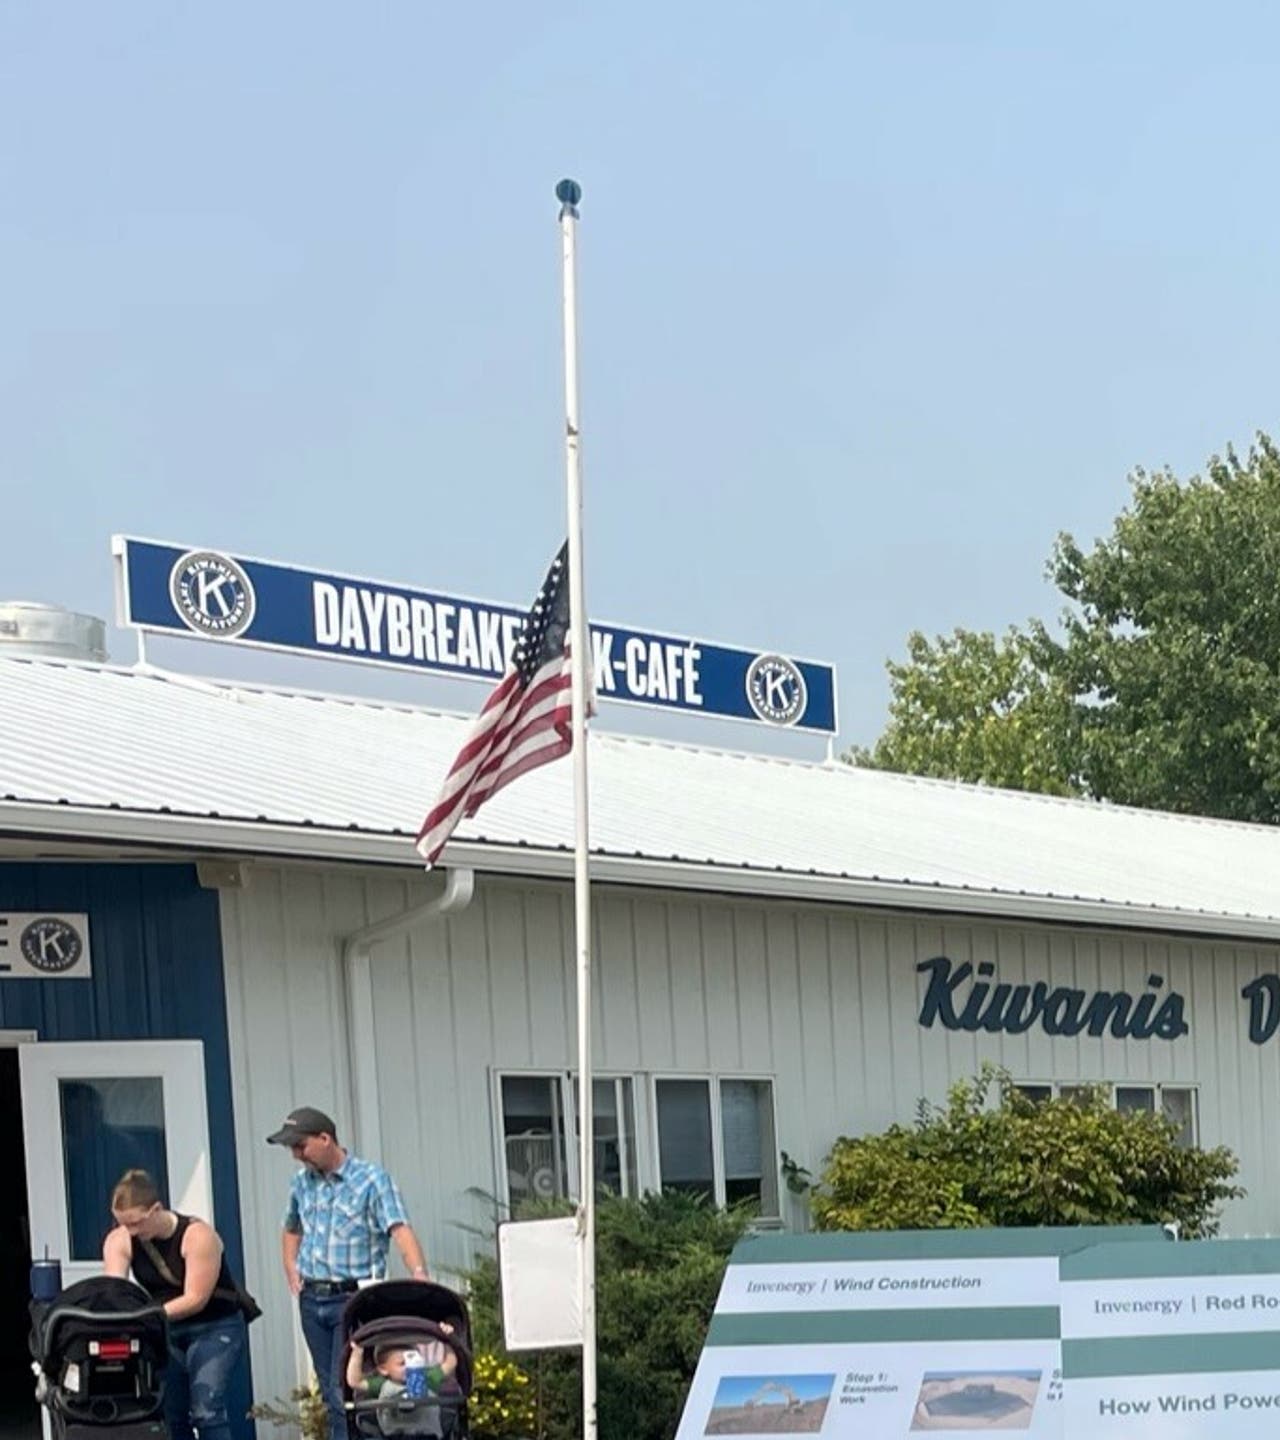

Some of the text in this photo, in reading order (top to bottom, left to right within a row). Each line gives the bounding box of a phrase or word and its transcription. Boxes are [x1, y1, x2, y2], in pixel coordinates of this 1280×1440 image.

[312, 581, 519, 674] DAYBREAKE
[917, 956, 1189, 1040] Kiwanis
[746, 1275, 982, 1295] Invenergy Wind Construction
[1094, 1299, 1183, 1314] Invenergy
[1205, 1295, 1246, 1311] Red
[846, 1372, 875, 1384] Step
[1099, 1398, 1151, 1416] How
[1158, 1394, 1216, 1412] Wind
